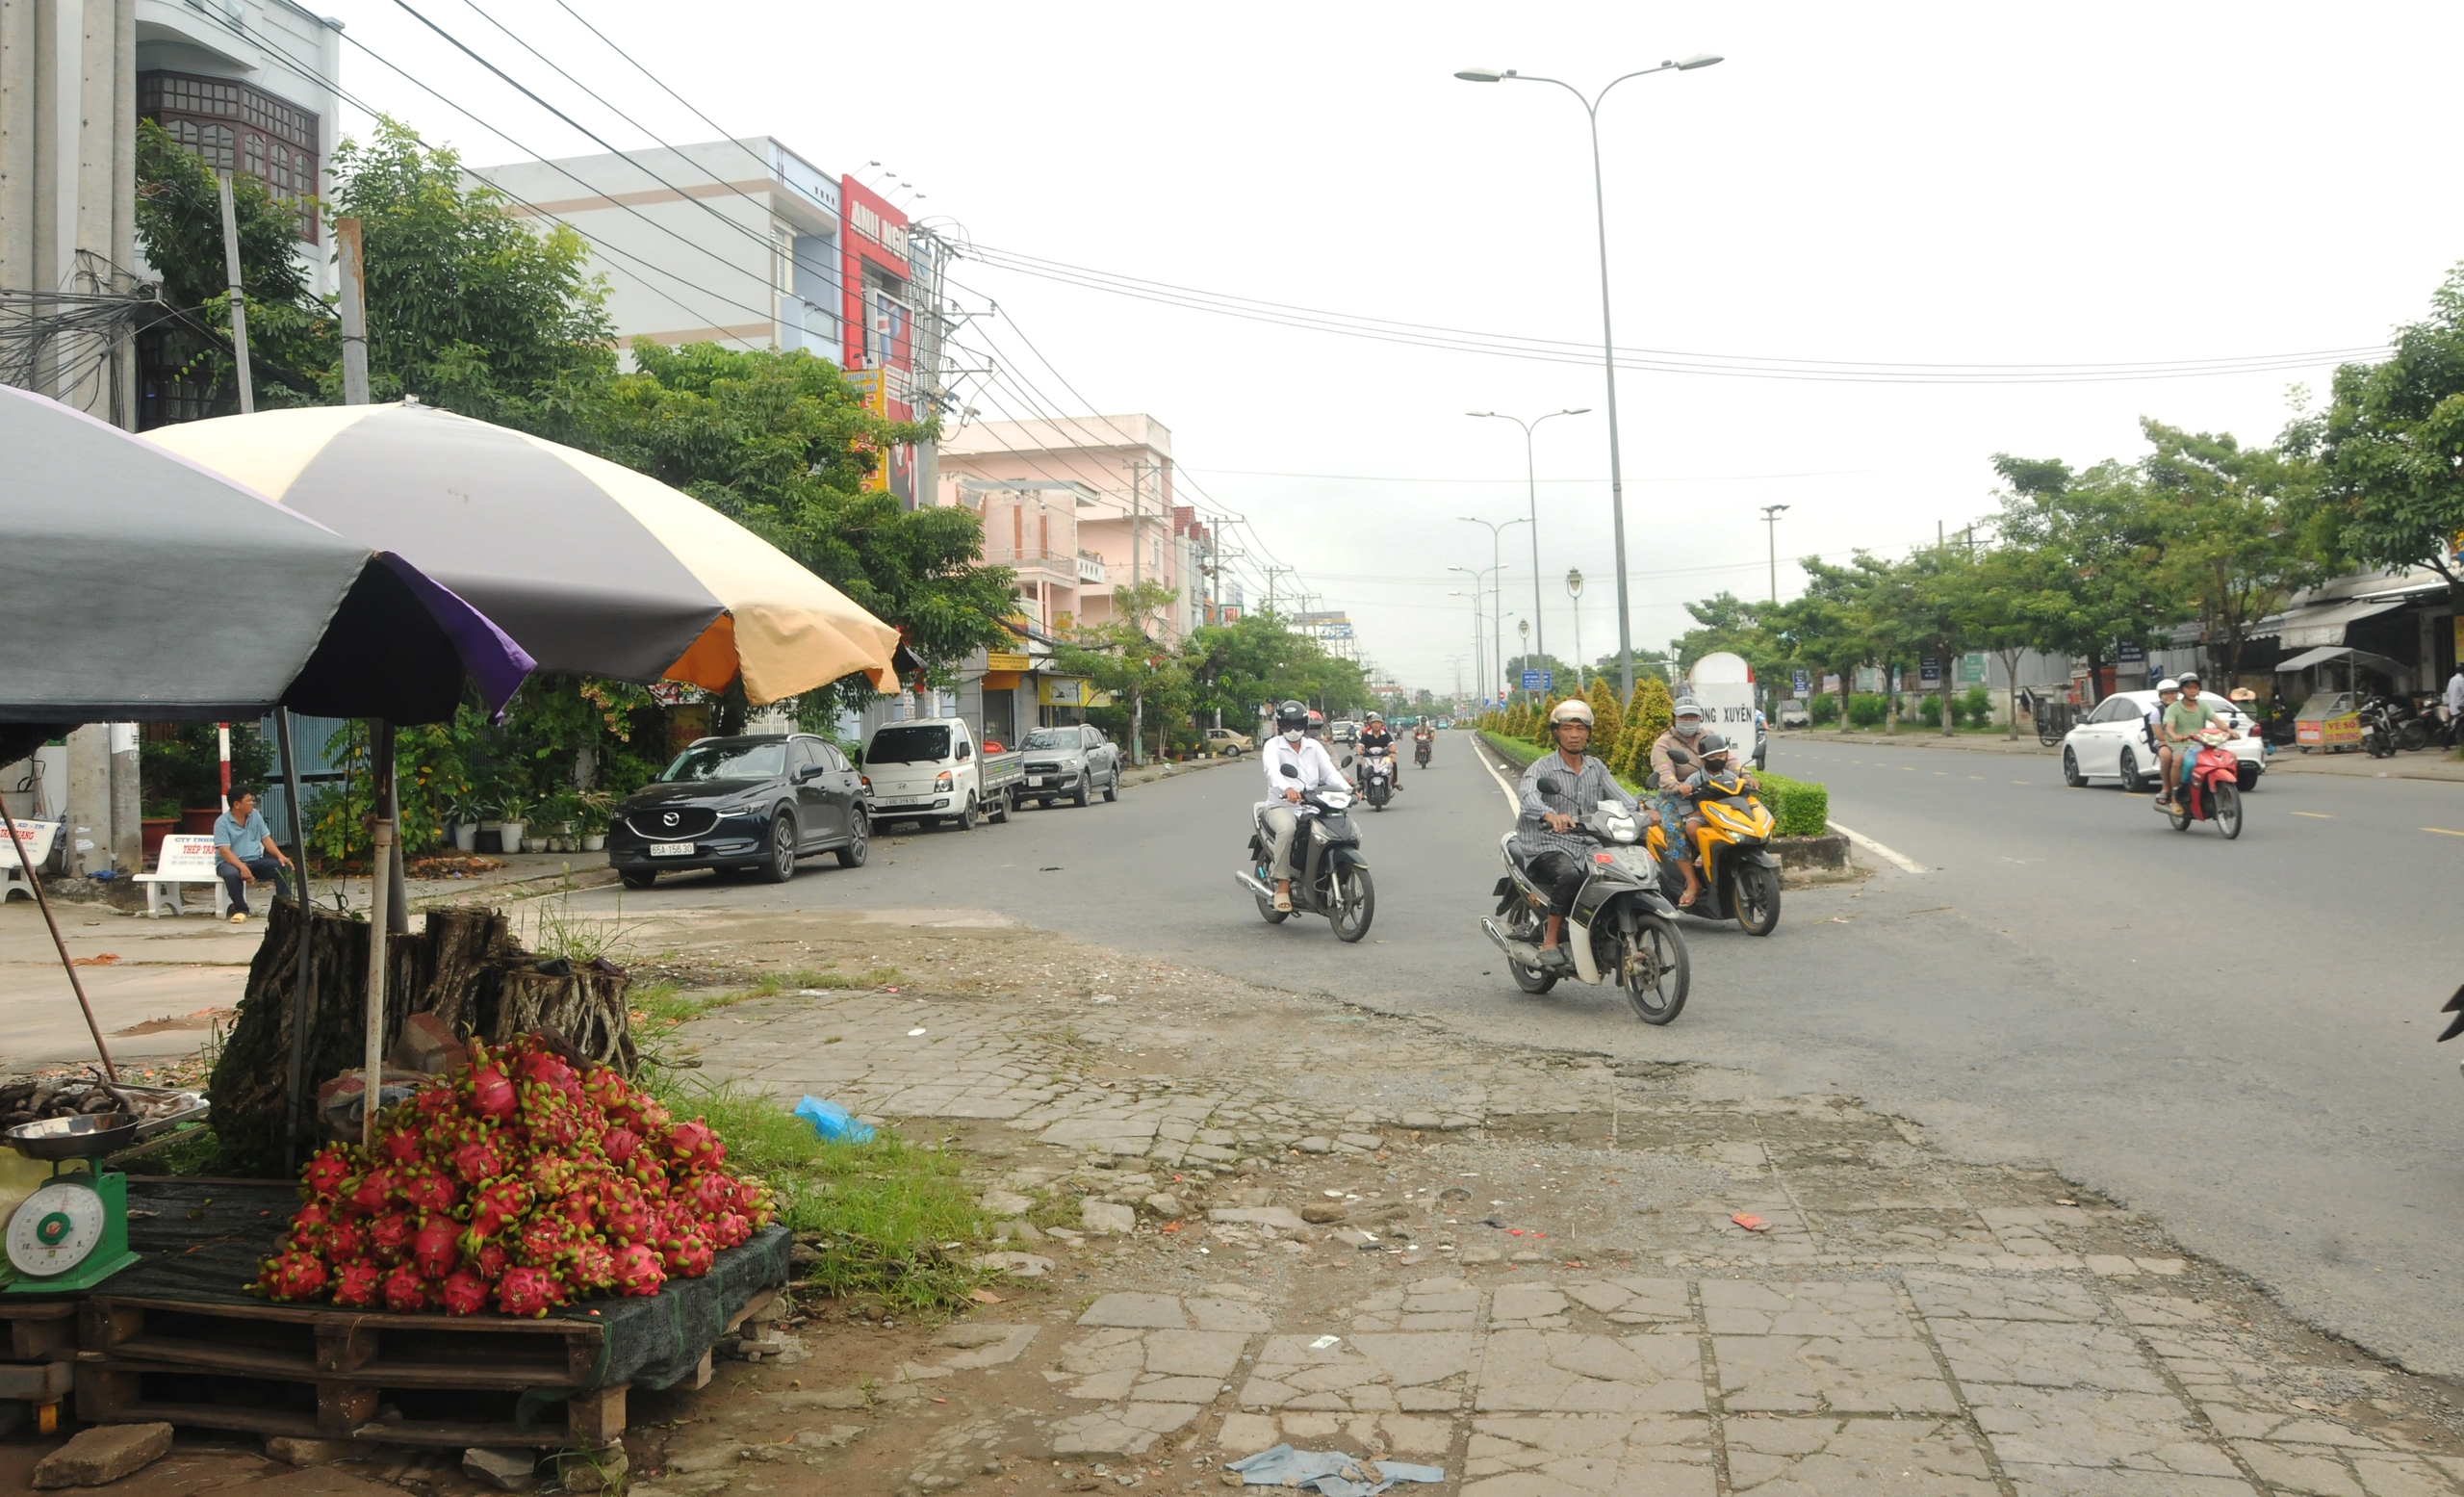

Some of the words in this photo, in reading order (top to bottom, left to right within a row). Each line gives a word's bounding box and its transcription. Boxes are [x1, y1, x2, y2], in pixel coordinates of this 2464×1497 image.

[1700, 708, 1716, 723] ONG
[1724, 703, 1752, 723] XUYÊN
[1725, 736, 1738, 750] Km
